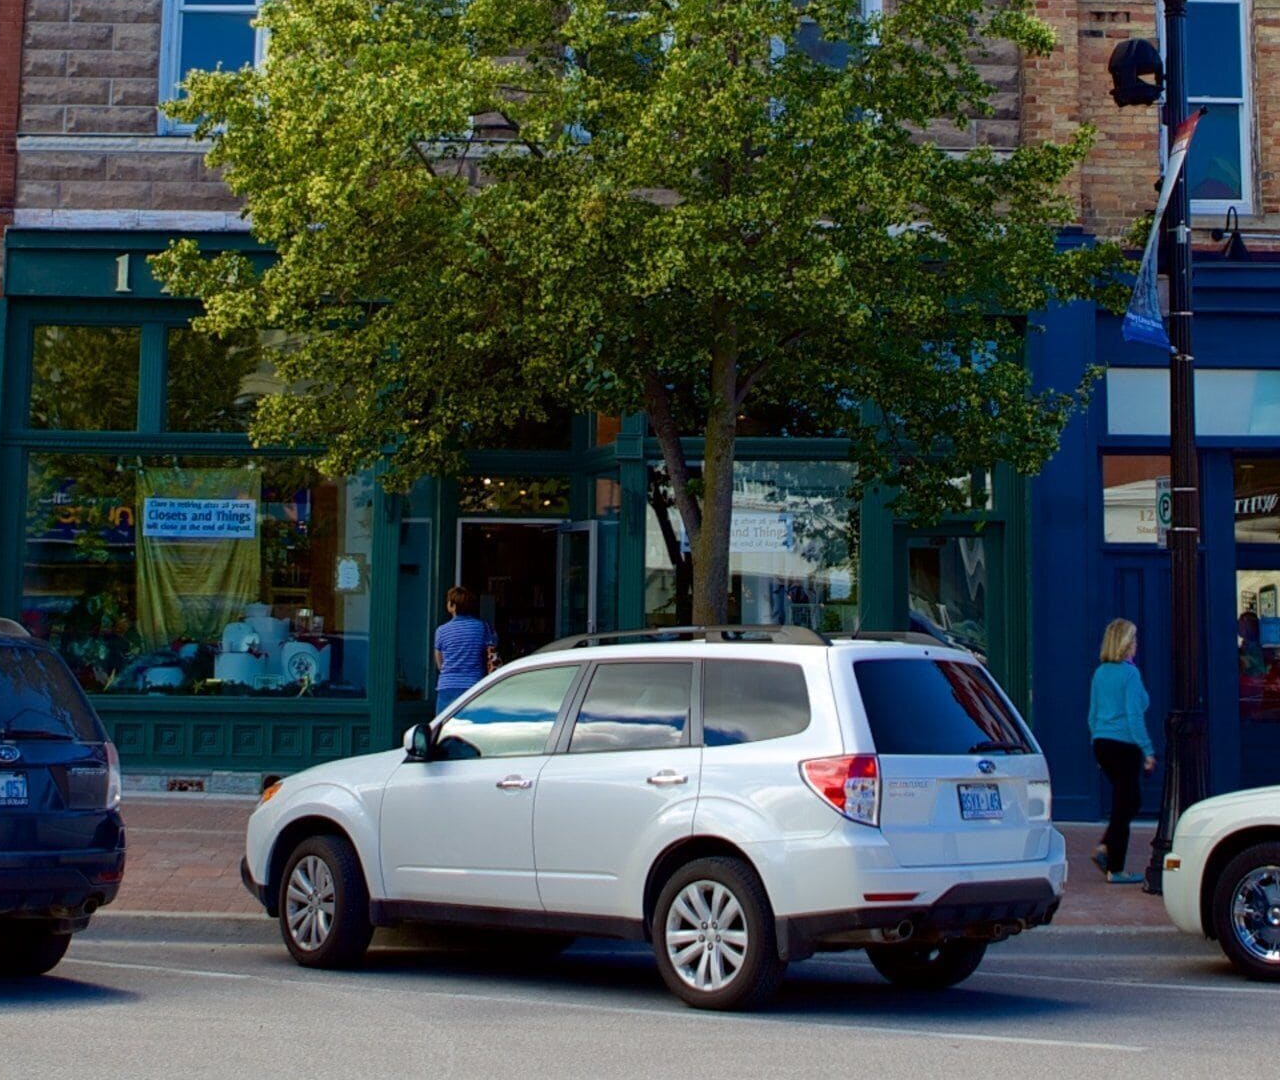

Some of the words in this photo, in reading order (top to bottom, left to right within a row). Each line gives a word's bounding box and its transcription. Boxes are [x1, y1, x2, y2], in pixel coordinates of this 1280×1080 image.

[148, 510, 188, 521] Closets
[191, 511, 212, 521] and
[216, 511, 251, 524] Things
